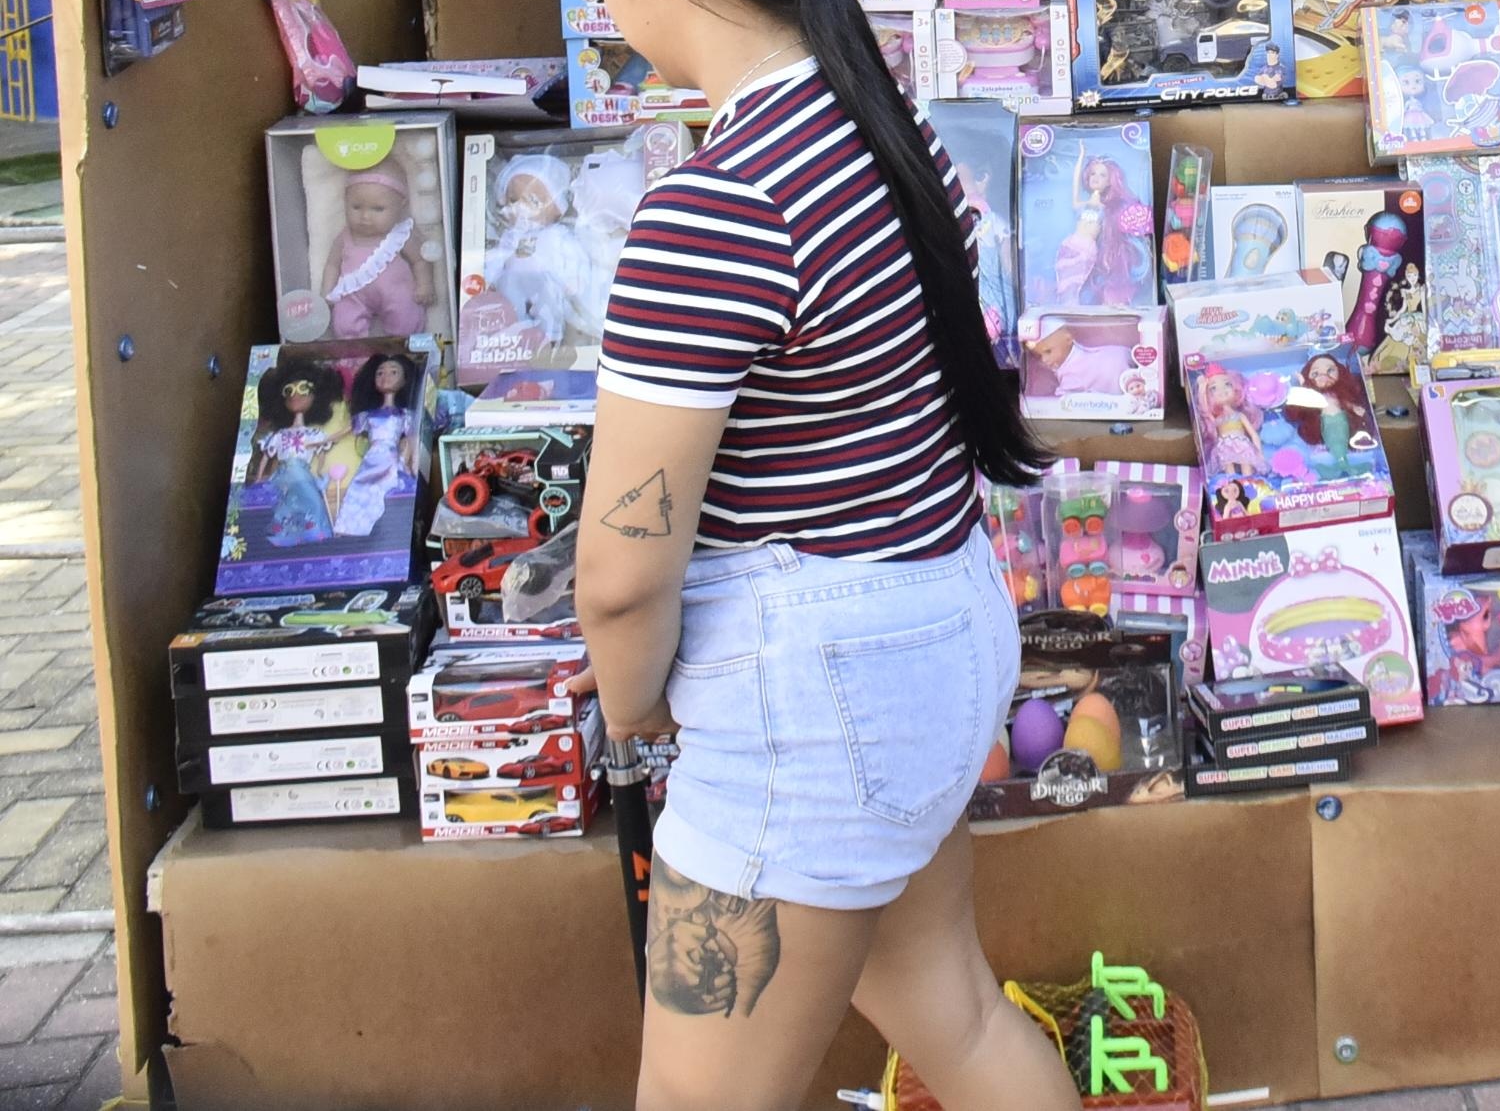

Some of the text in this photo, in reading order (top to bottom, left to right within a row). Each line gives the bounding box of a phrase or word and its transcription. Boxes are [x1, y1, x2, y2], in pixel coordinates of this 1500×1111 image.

[567, 6, 612, 22] CASH
[583, 23, 611, 32] DESK
[1202, 85, 1259, 99] POLICE
[575, 97, 641, 112] CASHIER
[591, 113, 619, 122] DESK
[1315, 200, 1365, 218] Fashion
[475, 334, 523, 350] Baby
[469, 347, 533, 365] Babble
[1275, 490, 1344, 509] HAPPY GIRL
[460, 628, 513, 637] MODEL
[1220, 716, 1252, 731] SUPER
[422, 726, 479, 738] MODEL
[422, 740, 479, 750] MODEL
[1227, 743, 1258, 758] SUPER
[1197, 771, 1229, 784] SUPER
[1031, 778, 1103, 800] DINOSAUR
[1056, 793, 1084, 804] EGG
[434, 825, 490, 837] MODEL
